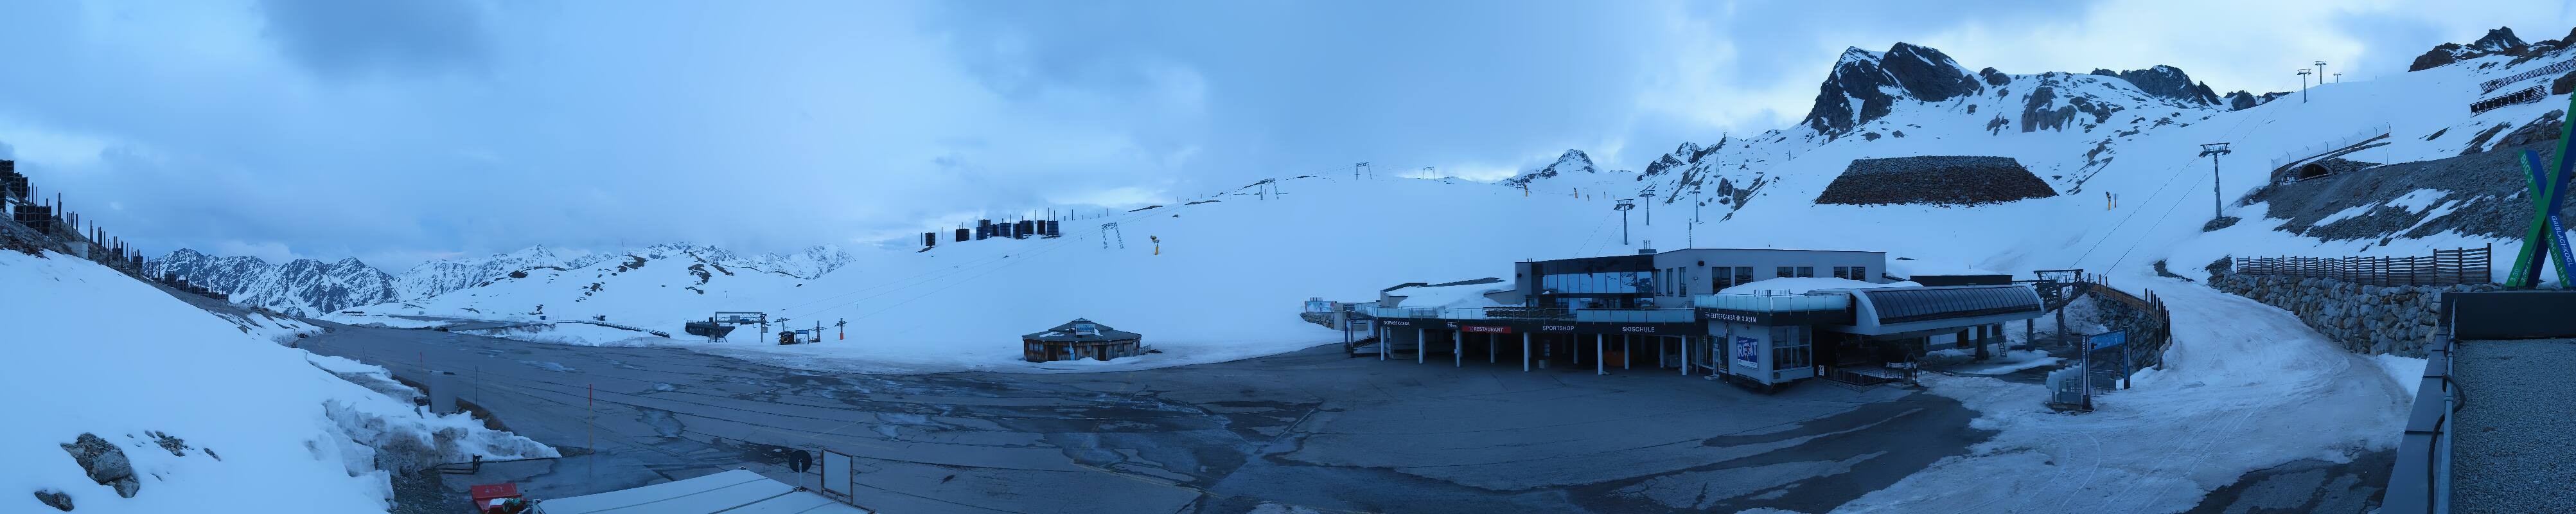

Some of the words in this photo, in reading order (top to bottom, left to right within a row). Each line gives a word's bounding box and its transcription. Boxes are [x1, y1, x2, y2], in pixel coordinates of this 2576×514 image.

[2520, 154, 2530, 175] BIG
[2527, 175, 2534, 184] 3
[2551, 215, 2572, 267] GAISLACHKOGL
